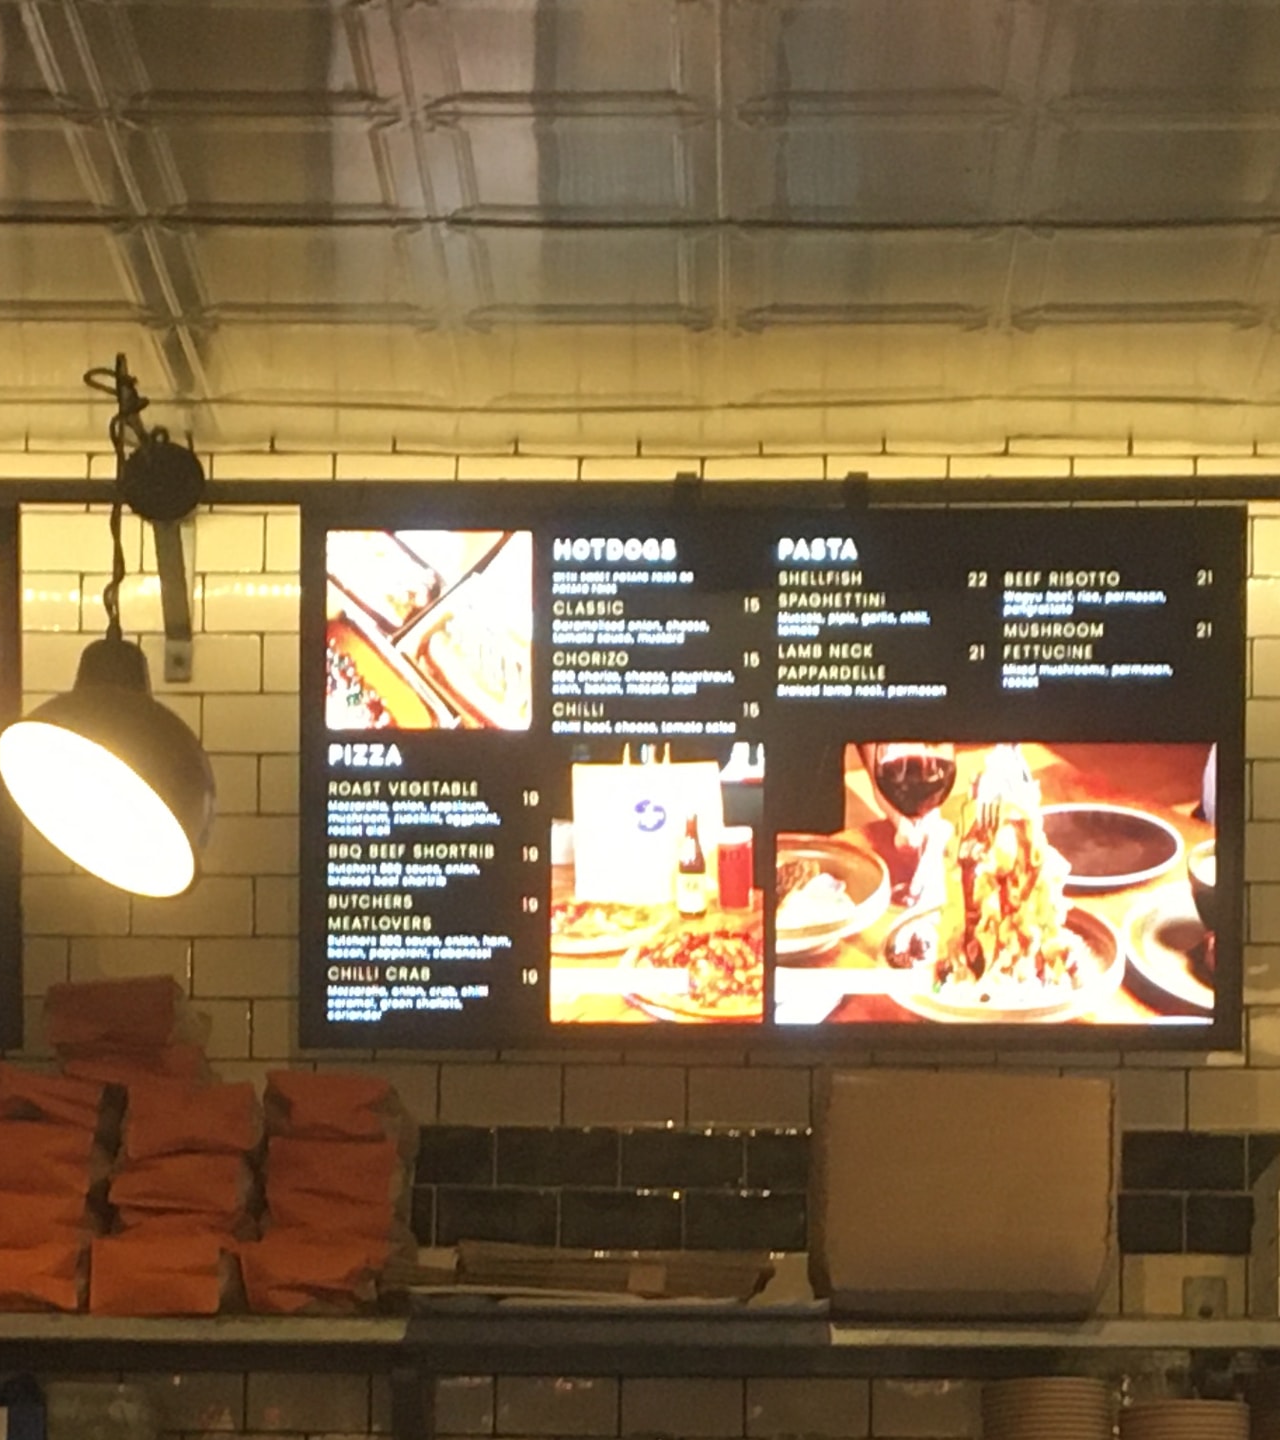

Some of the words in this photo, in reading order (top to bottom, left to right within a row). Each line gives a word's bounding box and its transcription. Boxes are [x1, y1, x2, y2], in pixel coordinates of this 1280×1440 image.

[553, 538, 676, 561] HOTDOGS
[778, 538, 858, 562] PASTA
[779, 571, 862, 585] SHELLFISH
[968, 572, 987, 587] 22
[1005, 572, 1040, 586] BEEF
[1049, 572, 1120, 586] RISOTTO
[1198, 570, 1212, 585] 21
[779, 593, 885, 607] SPAGHETTINI
[553, 601, 623, 615] CLASSIC
[1004, 623, 1103, 637] MUSHROOM
[1197, 622, 1211, 637] 21
[553, 651, 628, 666] CHORIZO
[779, 644, 822, 658] LAMB
[829, 644, 872, 658] NECK
[970, 645, 984, 660] 21
[1004, 645, 1091, 659] FETTUCINE
[778, 666, 884, 680] PAPPARDELLE
[553, 702, 603, 717] CHILLI
[329, 744, 402, 767] PIZZA
[329, 781, 380, 796] ROAST
[389, 781, 477, 796] VEGETABLE
[329, 844, 362, 859] BBQ
[370, 844, 405, 858] BEEF
[414, 844, 494, 859] SHORTRIB
[329, 895, 412, 909] BUTCHERS
[328, 916, 431, 930] MEATLOVERS
[328, 966, 378, 981] CHILLI
[386, 967, 430, 981] CRAB
